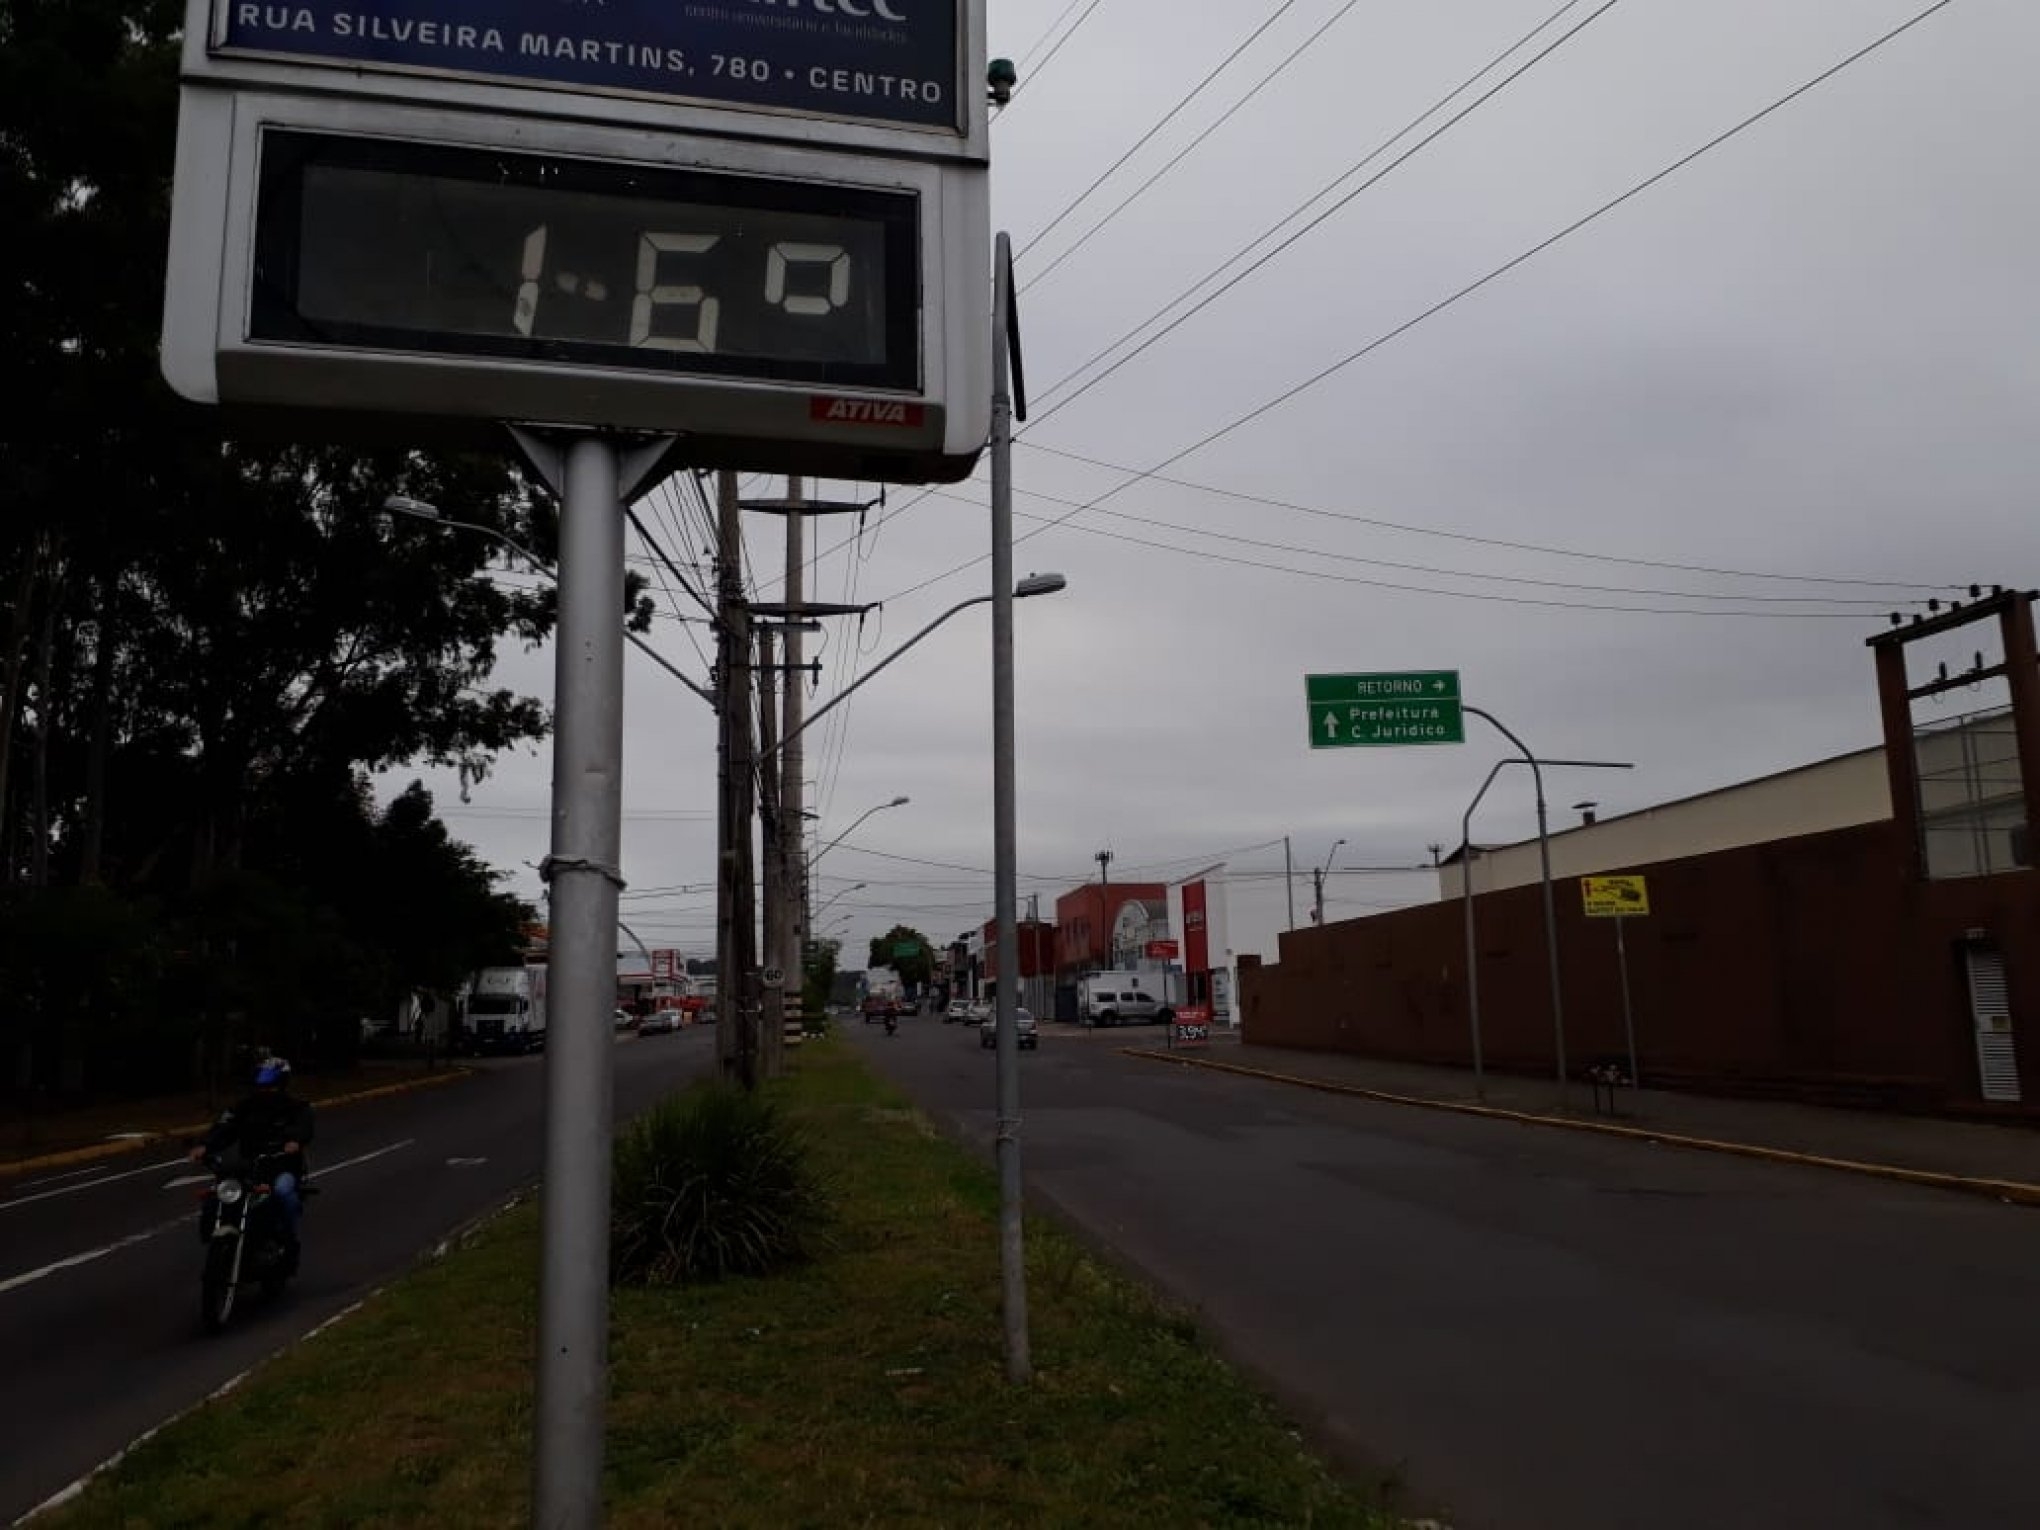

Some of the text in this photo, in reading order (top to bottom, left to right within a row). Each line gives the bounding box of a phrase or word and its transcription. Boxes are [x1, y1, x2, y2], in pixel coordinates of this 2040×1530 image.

[237, 3, 942, 104] RUA SILVEIRA MARTINS, 780 CENTRO
[825, 399, 906, 422] ATIVA
[1357, 679, 1423, 695] RETORNO
[1349, 706, 1440, 721] Prefeitura
